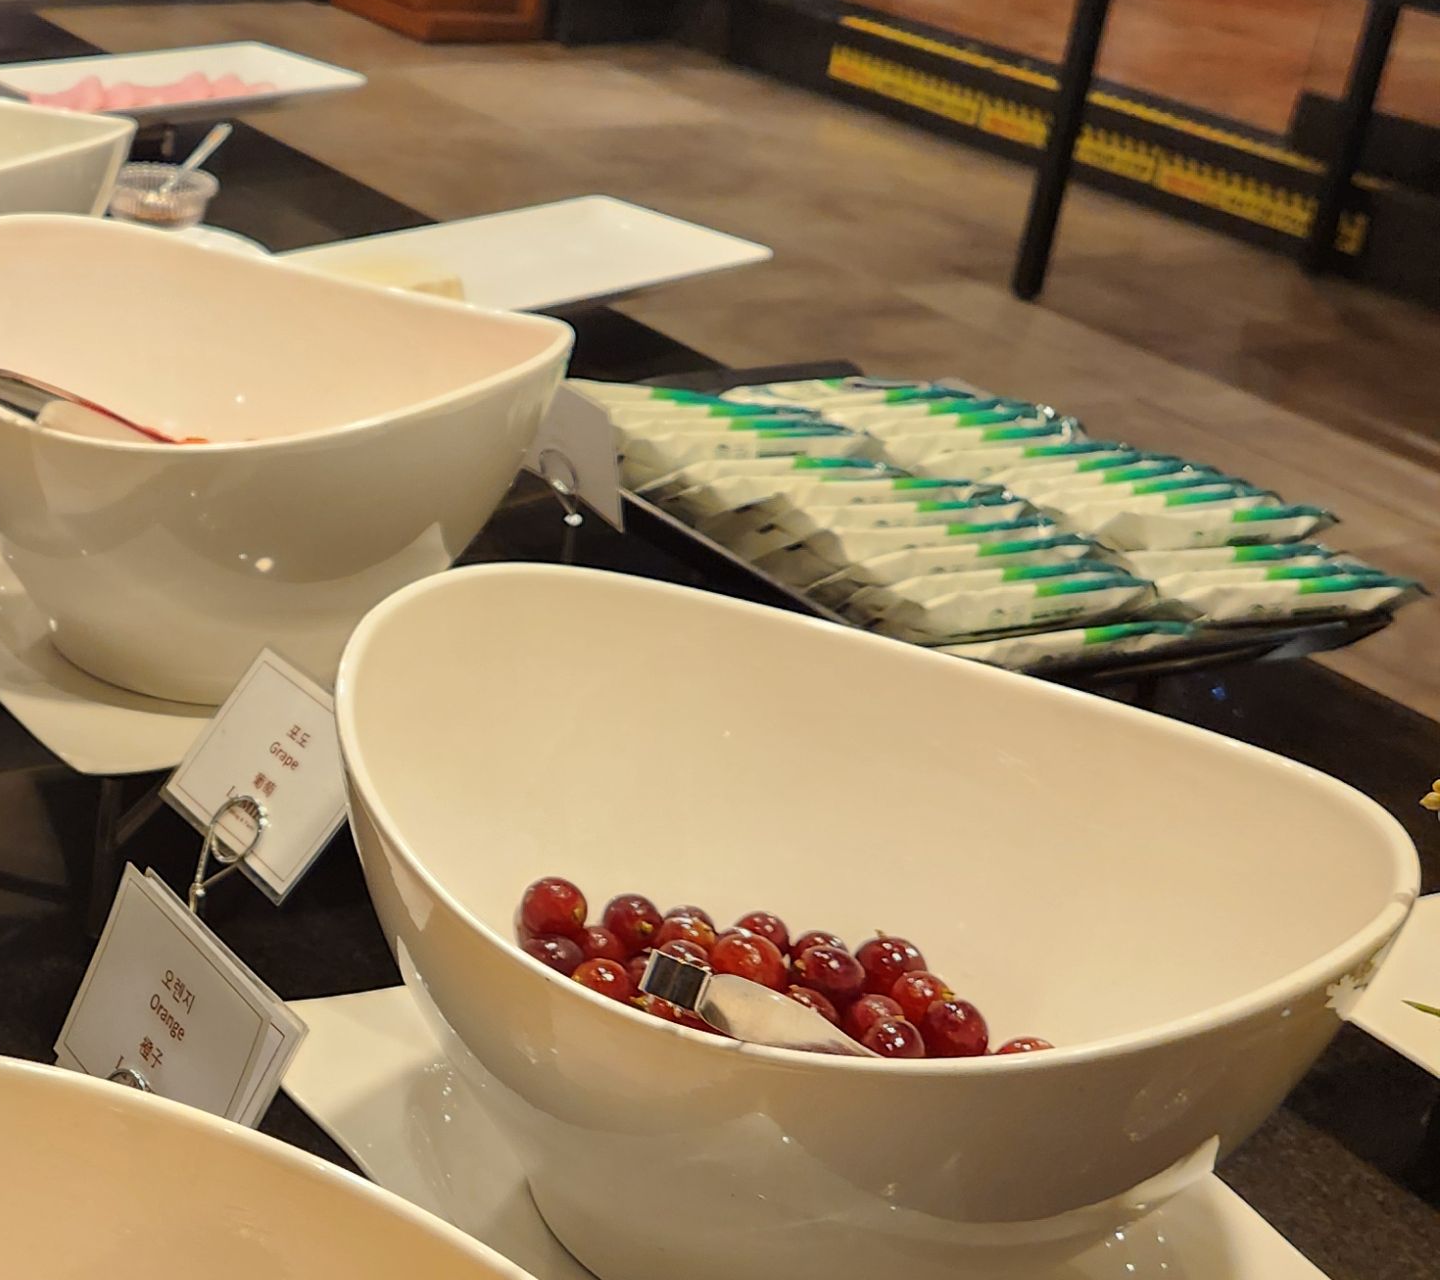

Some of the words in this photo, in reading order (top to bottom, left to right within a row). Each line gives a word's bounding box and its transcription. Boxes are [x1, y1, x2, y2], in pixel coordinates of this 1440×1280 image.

[286, 724, 311, 749] 포도
[269, 741, 300, 771] Grape
[161, 969, 196, 1015] 오렌지
[149, 993, 185, 1041] Orange
